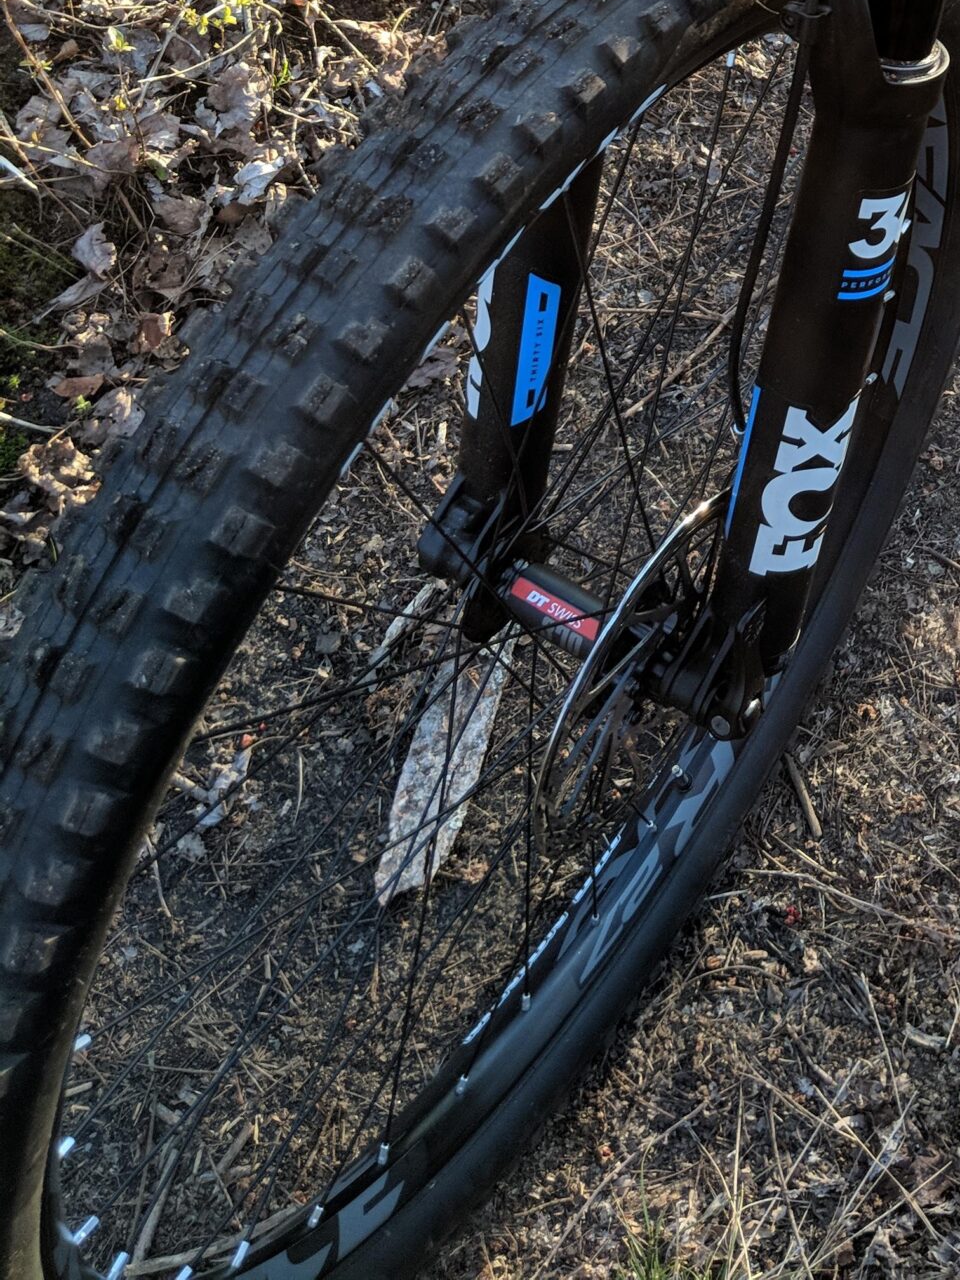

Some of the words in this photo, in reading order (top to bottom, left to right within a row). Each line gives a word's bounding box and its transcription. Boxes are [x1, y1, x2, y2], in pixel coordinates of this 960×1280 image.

[535, 318, 545, 338] SIX
[529, 343, 542, 383] THIRTY
[748, 394, 860, 577] FOX
[526, 589, 551, 608] DT
